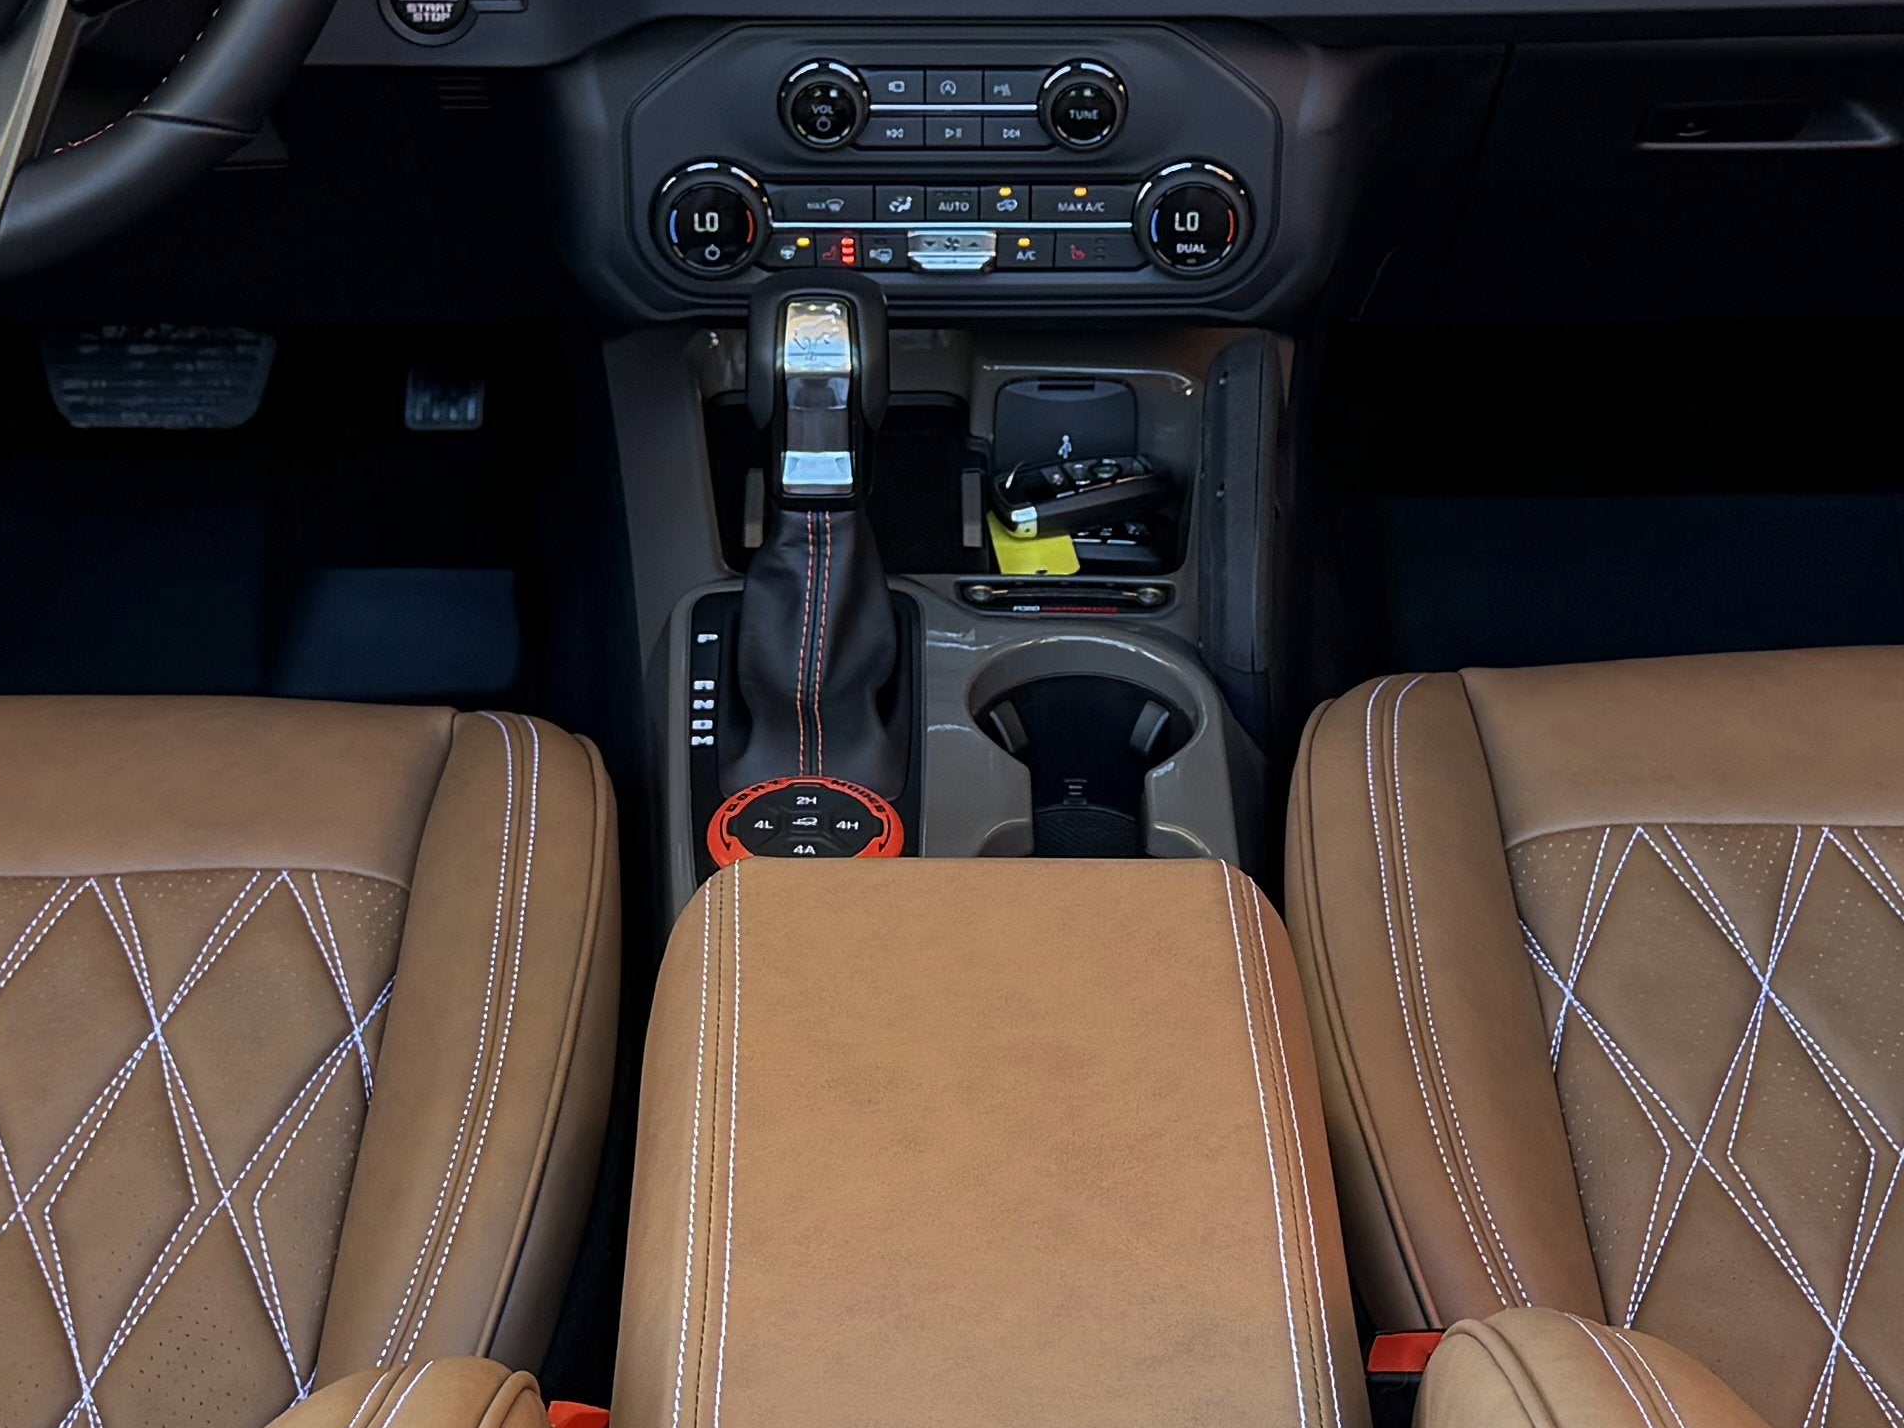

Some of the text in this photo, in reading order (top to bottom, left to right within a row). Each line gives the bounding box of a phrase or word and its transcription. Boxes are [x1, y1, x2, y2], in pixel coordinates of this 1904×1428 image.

[406, 3, 453, 13] START
[413, 12, 450, 22] STOP
[811, 104, 834, 115] VOL
[1069, 109, 1100, 121] TUNE
[938, 202, 970, 213] AUTO
[1057, 201, 1105, 213] MAX A/C
[693, 212, 719, 233] LO
[1175, 211, 1199, 232] LO
[1176, 243, 1207, 254] DUAL
[1016, 250, 1036, 261] A/C
[796, 796, 817, 806] 2H
[831, 779, 887, 813] MODES
[753, 820, 774, 830] 4L
[836, 820, 859, 830] 4H
[793, 845, 816, 855] 4A
